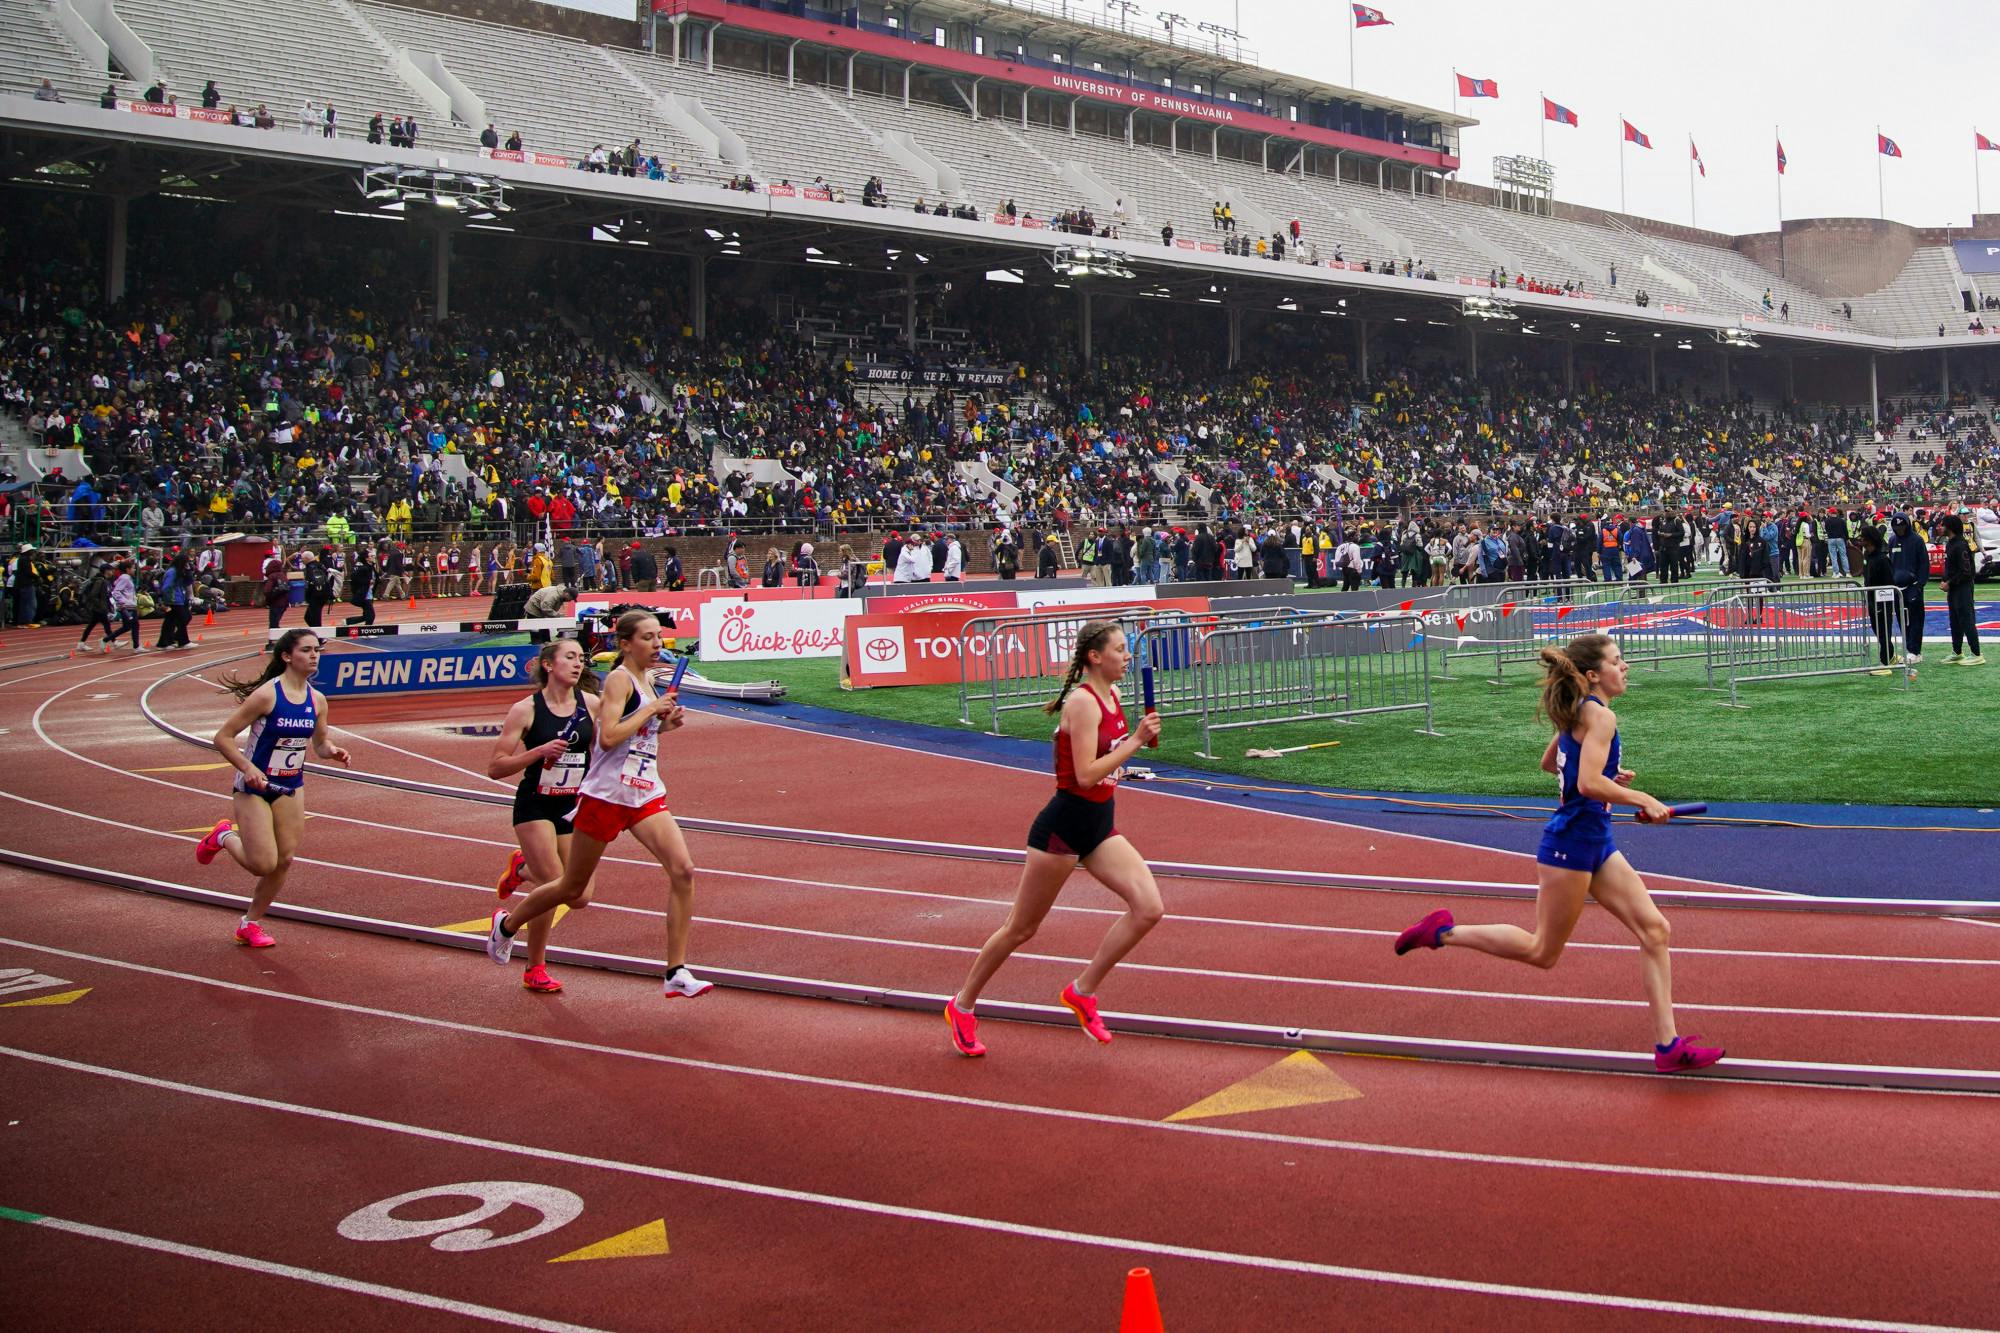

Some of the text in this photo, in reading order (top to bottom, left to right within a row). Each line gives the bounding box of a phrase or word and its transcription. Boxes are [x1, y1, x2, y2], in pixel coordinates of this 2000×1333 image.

[1053, 75, 1233, 121] UNIVERSITY OF PENNSYLVANIA
[135, 104, 174, 115] TOYOTA
[193, 111, 230, 121] TOYOTA
[493, 151, 523, 160] TOYOTA
[538, 156, 565, 166] TOYOTA
[868, 369, 899, 380] HOME
[901, 370, 914, 380] OF
[939, 372, 965, 382] PEN
[484, 622, 507, 631] TOYOTA
[718, 611, 845, 655] Chick-fil-A
[914, 632, 1026, 659] TOYOTA
[336, 654, 517, 688] PENN RELAYS
[276, 717, 315, 729] SHAKER
[284, 752, 298, 769] C
[637, 758, 651, 777] F
[555, 769, 570, 787] J
